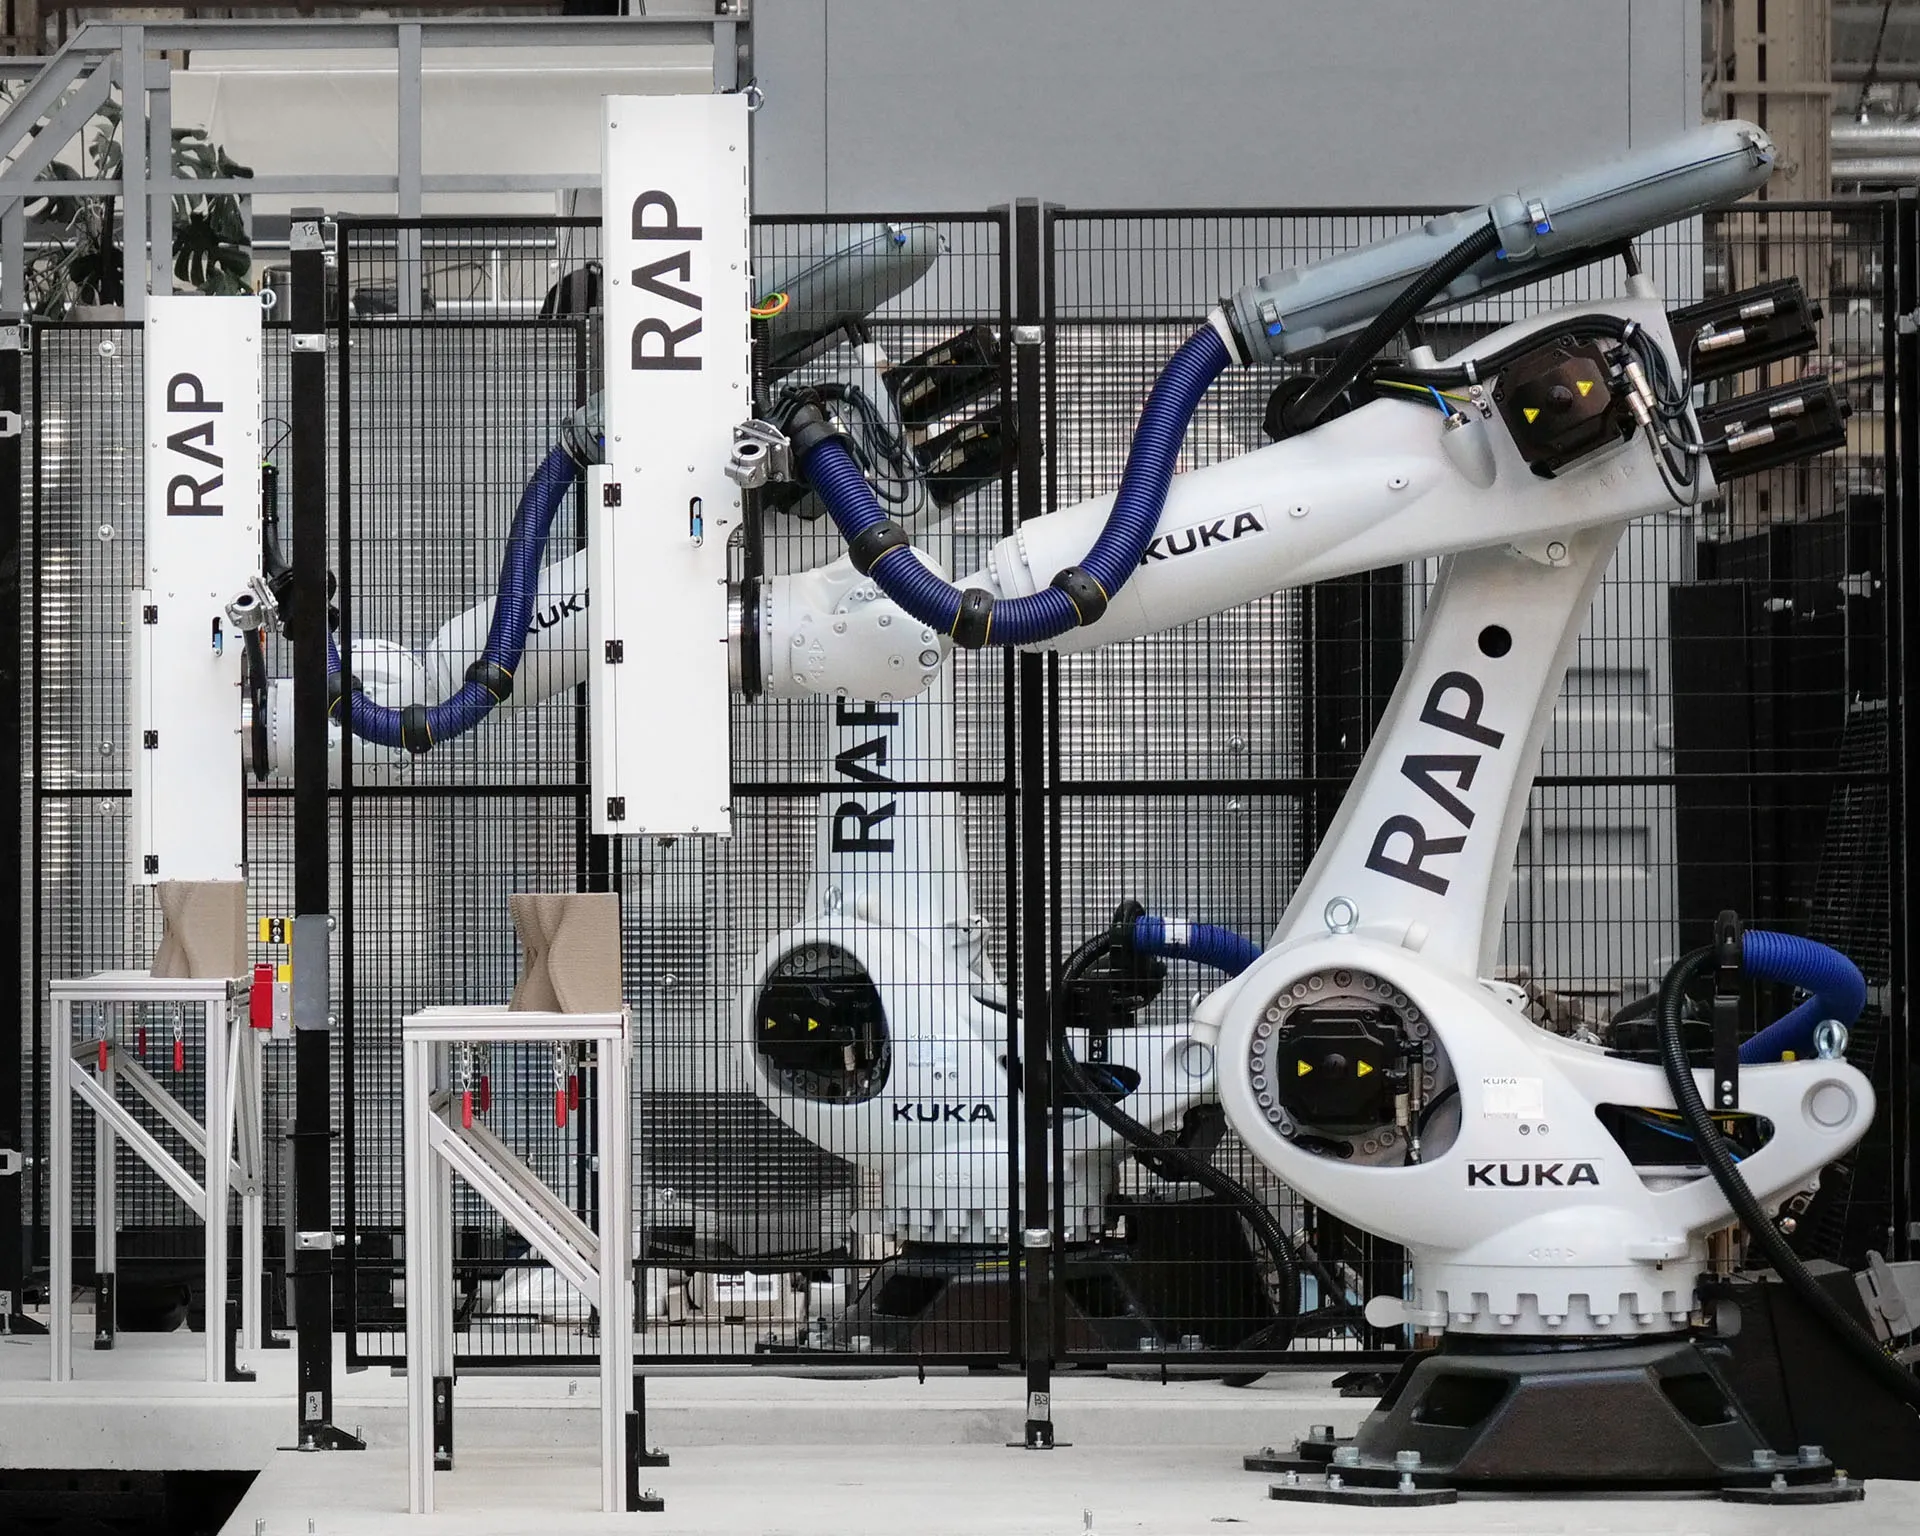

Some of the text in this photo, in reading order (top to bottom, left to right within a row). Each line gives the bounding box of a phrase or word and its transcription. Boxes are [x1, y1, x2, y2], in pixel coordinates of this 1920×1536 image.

[632, 191, 702, 371] RAP
[167, 372, 224, 516] RAP
[1140, 511, 1264, 566] KUKA
[528, 588, 589, 634] UK
[1364, 670, 1505, 896] RAP
[893, 1103, 995, 1122] KUKA
[1468, 1163, 1600, 1187] KUKA
